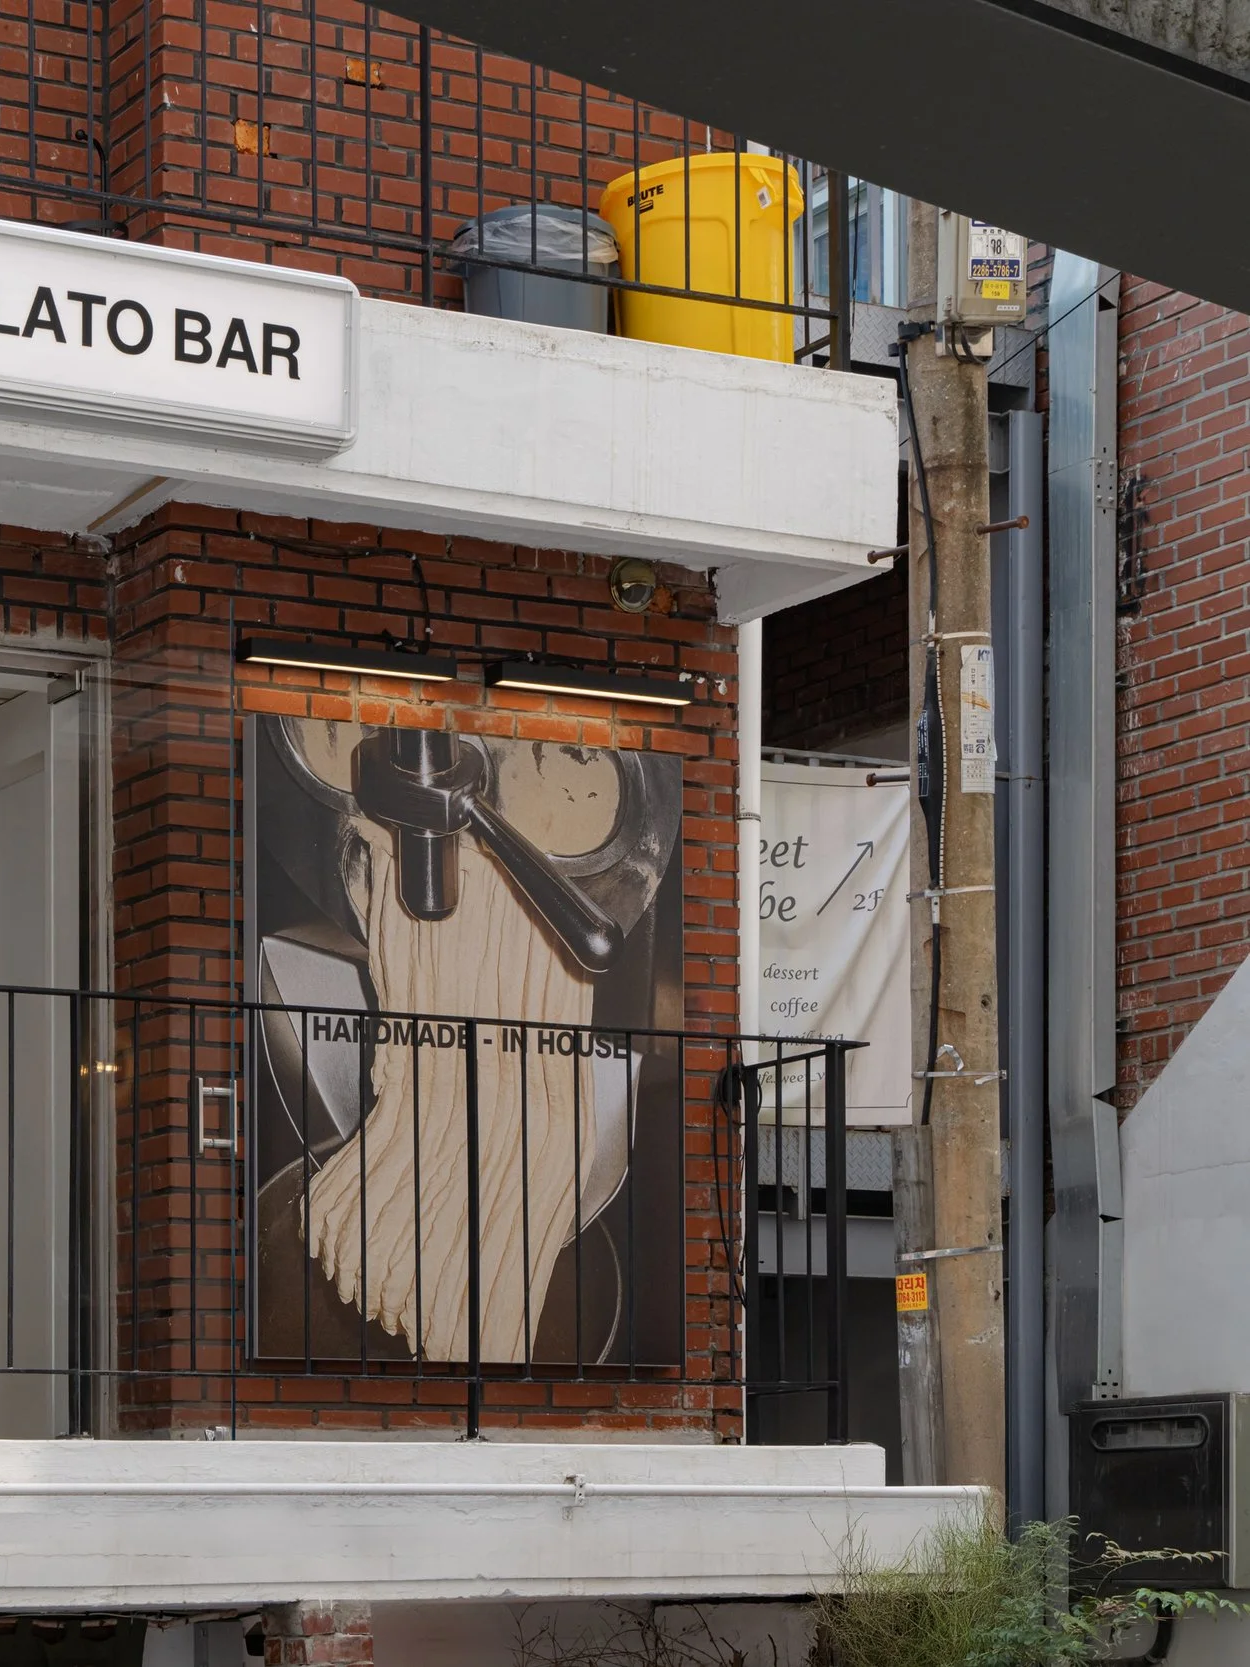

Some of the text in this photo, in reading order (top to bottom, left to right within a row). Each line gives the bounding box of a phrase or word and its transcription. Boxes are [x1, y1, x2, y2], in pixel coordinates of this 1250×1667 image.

[627, 184, 664, 208] BUTE
[174, 308, 302, 381] BAR
[852, 888, 884, 912] 2F
[763, 962, 820, 981] dessert
[770, 997, 819, 1018] coffee
[312, 1015, 469, 1050] HANDMADE
[502, 1027, 527, 1053] IN
[537, 1029, 629, 1060] HOUSE
